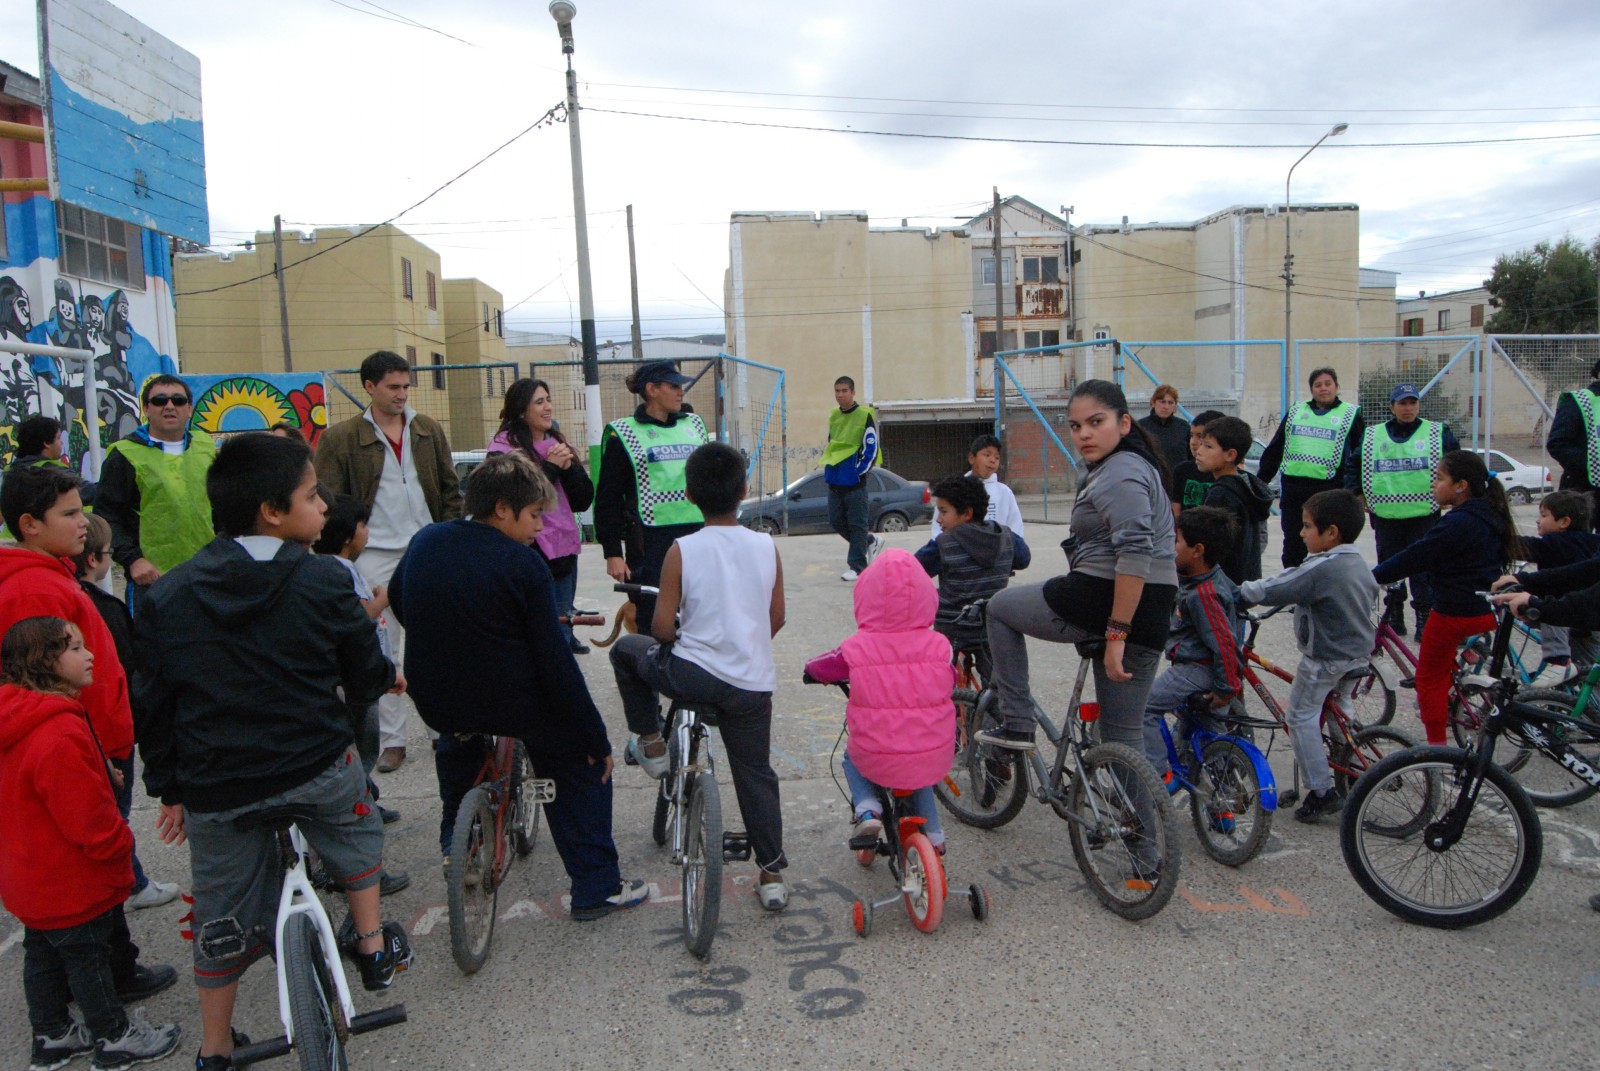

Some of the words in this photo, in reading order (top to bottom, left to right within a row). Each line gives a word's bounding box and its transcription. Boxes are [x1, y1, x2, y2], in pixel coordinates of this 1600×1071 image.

[1295, 426, 1331, 435] POLICIA
[652, 445, 697, 455] POLICI
[1378, 458, 1423, 467] POLICIA
